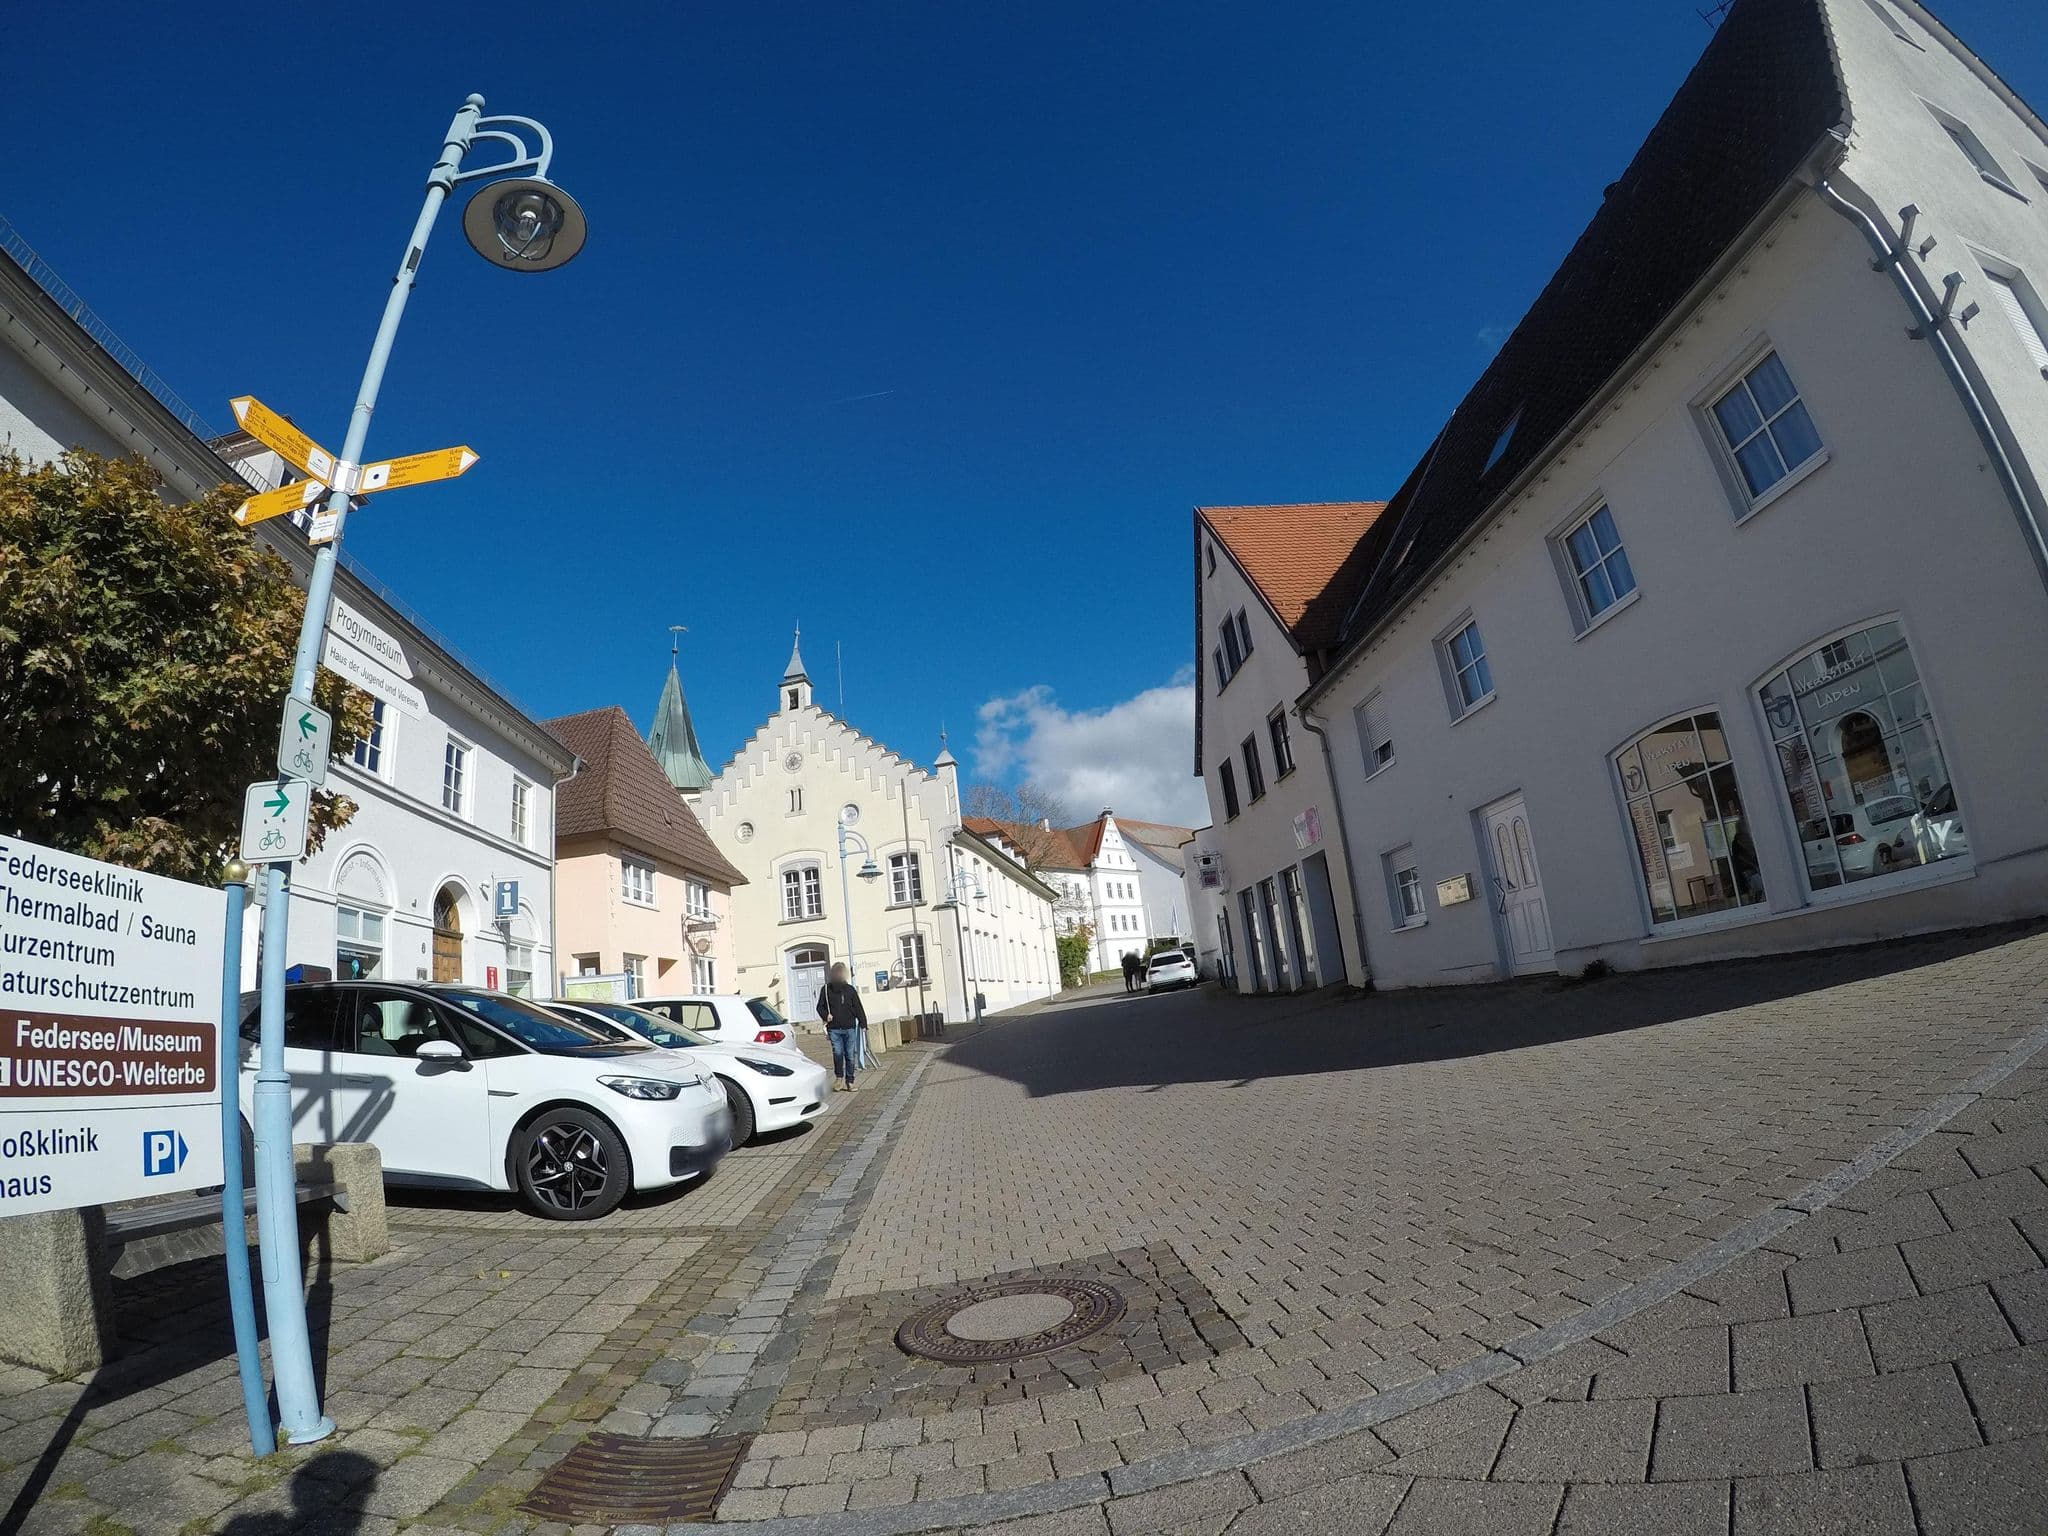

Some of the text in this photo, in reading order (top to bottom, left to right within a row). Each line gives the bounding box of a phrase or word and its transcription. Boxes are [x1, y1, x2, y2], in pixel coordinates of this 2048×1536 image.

[336, 606, 402, 665] Progymnasium
[330, 646, 419, 711] Haus der Jugend und Vereine
[0, 925, 115, 967] urzentrum
[141, 915, 196, 945] Sauna
[0, 967, 194, 1009] aturschutzzentrum
[16, 1019, 202, 1052] Federsee/Museum
[16, 1058, 206, 1087] UNESCO-Welterbe
[3, 1127, 99, 1158] oßklinik
